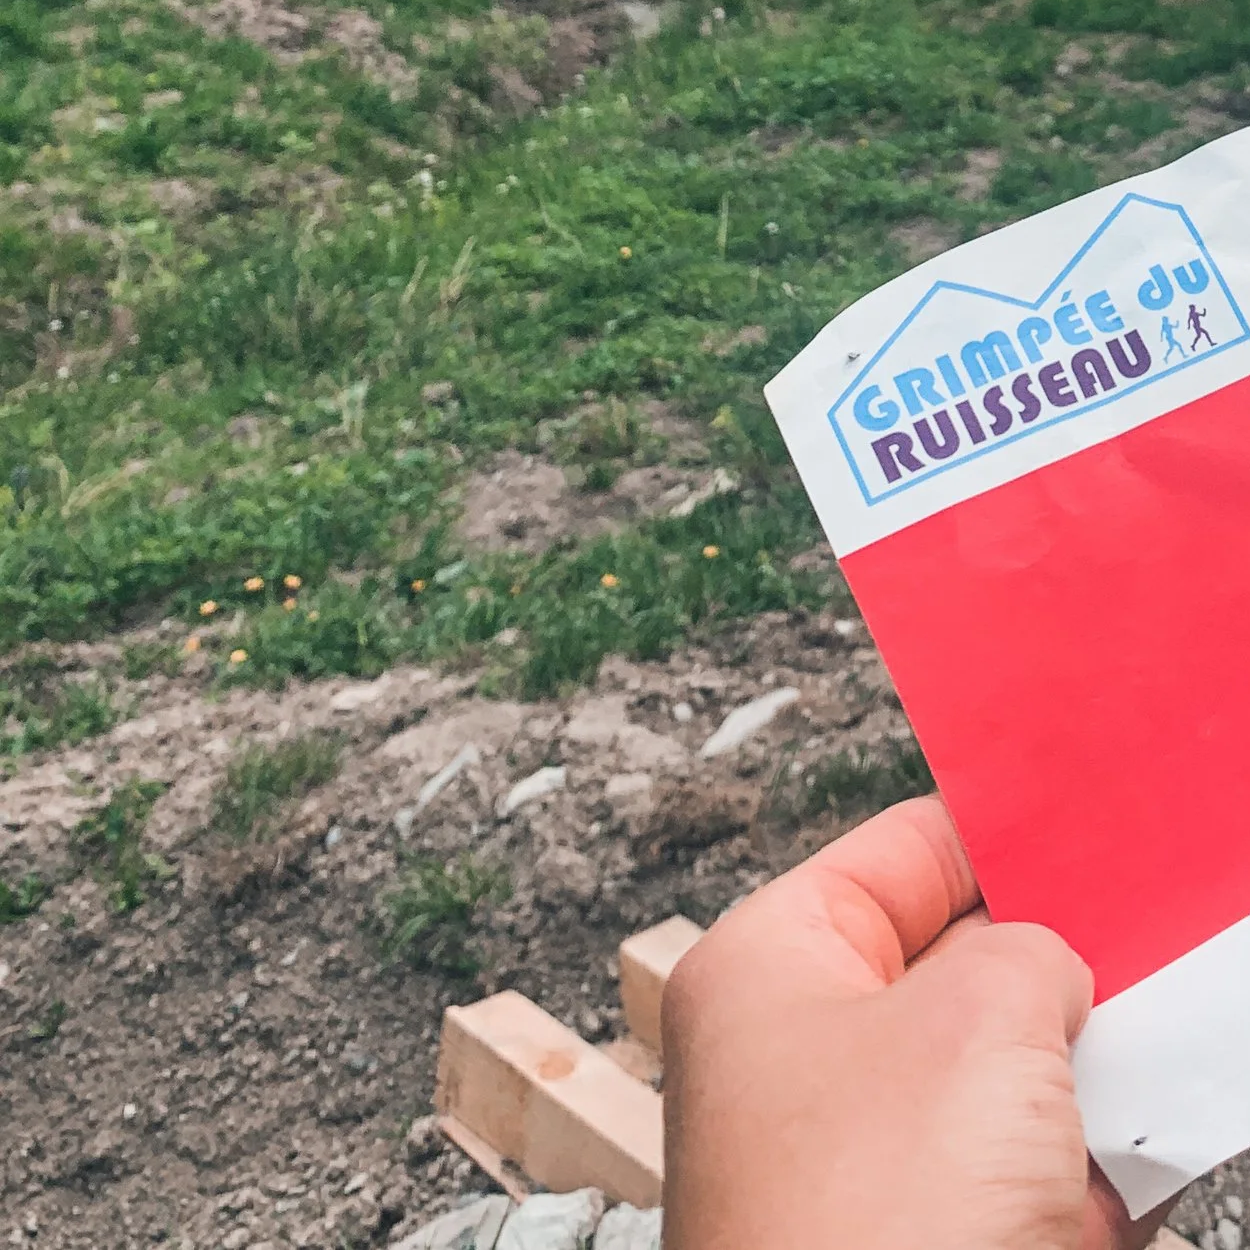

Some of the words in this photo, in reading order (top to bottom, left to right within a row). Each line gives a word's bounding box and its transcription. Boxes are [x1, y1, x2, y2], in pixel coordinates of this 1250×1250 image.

[853, 290, 1125, 432] GRIMPÉE
[1137, 258, 1210, 311] du
[870, 329, 1153, 483] RUISSEAU
